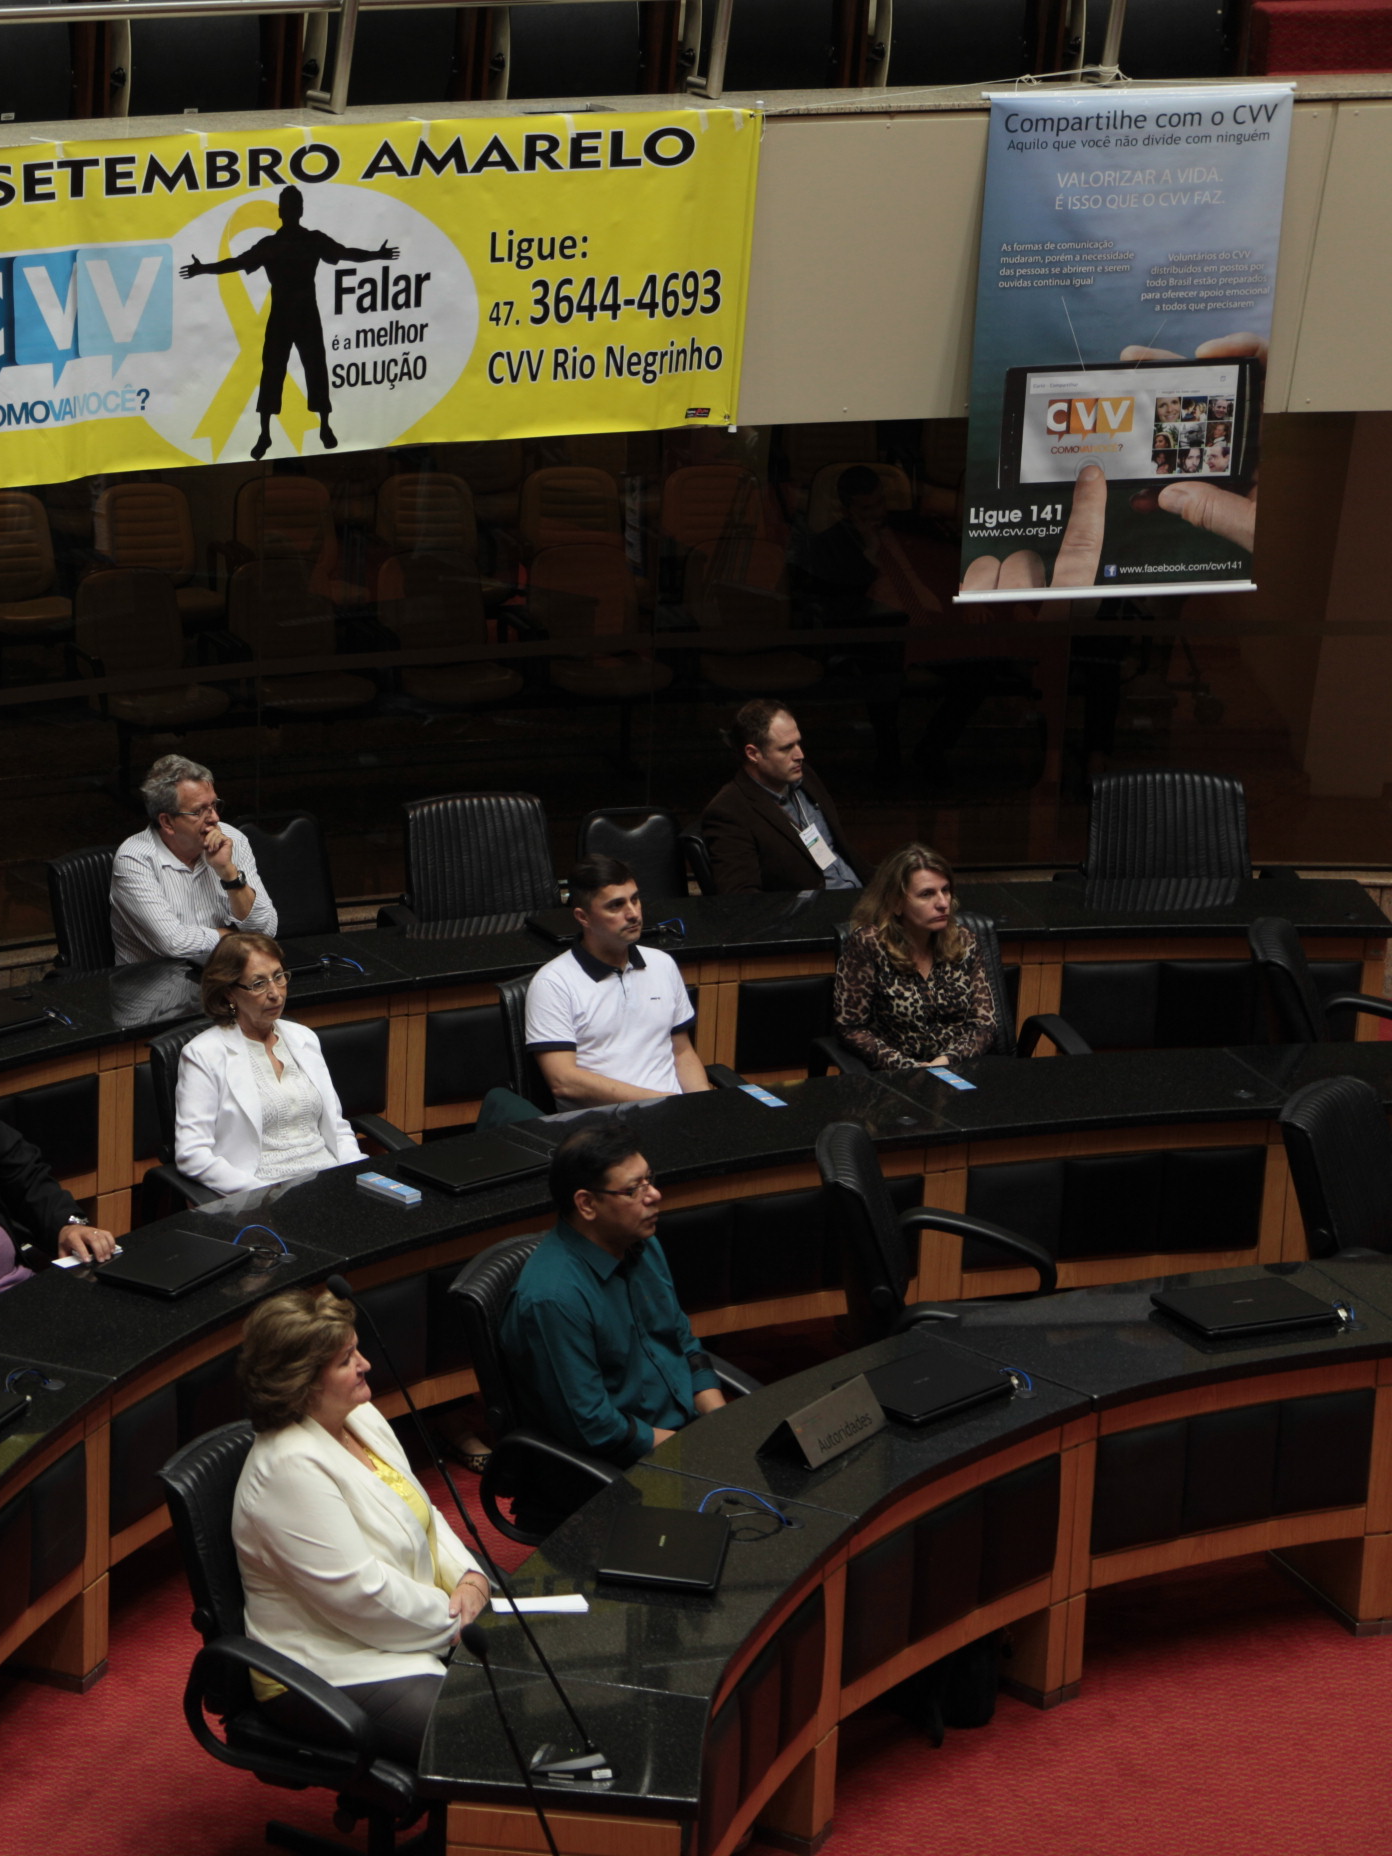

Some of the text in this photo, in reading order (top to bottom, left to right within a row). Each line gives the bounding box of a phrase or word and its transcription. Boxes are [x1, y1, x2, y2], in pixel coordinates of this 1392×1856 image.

[1004, 103, 1278, 137] Compartilhe com o CVV
[1007, 129, 1270, 152] Aquilo que você não divide com ninguém
[359, 126, 696, 180] AMARELO
[1057, 166, 1224, 188] VALORIZAR A VIDA.
[1055, 192, 1064, 210] É
[1068, 195, 1102, 210] ISSO
[1106, 193, 1139, 209] QUE
[1143, 193, 1155, 207] O
[1159, 192, 1190, 206] CVV
[489, 229, 589, 270] Ligue:
[1001, 240, 1113, 252] As formas de comunicação
[1045, 252, 1073, 263] porém
[1082, 251, 1134, 261] necessidade
[1168, 250, 1251, 261] Voluntários do CVV
[999, 267, 1014, 276] das
[1016, 266, 1049, 277] pessoas
[1051, 266, 1060, 274] se
[1062, 264, 1095, 273] abrirem
[1104, 264, 1130, 272] serem
[1204, 264, 1217, 272] em
[1220, 263, 1248, 273] postos
[1250, 263, 1264, 272] por
[334, 265, 431, 315] Falar
[998, 276, 1094, 288] ouvidas continua igual
[1146, 278, 1166, 287] todo
[1169, 277, 1191, 286] Brasil
[1219, 274, 1267, 286] preparados
[489, 269, 721, 327] 47. 3644-4693
[1141, 286, 1270, 301] para oferecer apoio emocional
[1162, 302, 1186, 311] todos
[1189, 302, 1205, 311] que
[1207, 300, 1254, 310] precisarem
[331, 319, 428, 351] é a melhor
[331, 351, 427, 389] SOLUÇÃO
[488, 337, 723, 385] CVV Rio Negrinho
[1047, 401, 1130, 432] CVV
[969, 504, 1062, 528] Ligue 141
[968, 524, 1062, 538] www.cvv.org.br
[1119, 561, 1243, 574] www.facebook.com/cvv141
[817, 1413, 872, 1453] Autoridades
